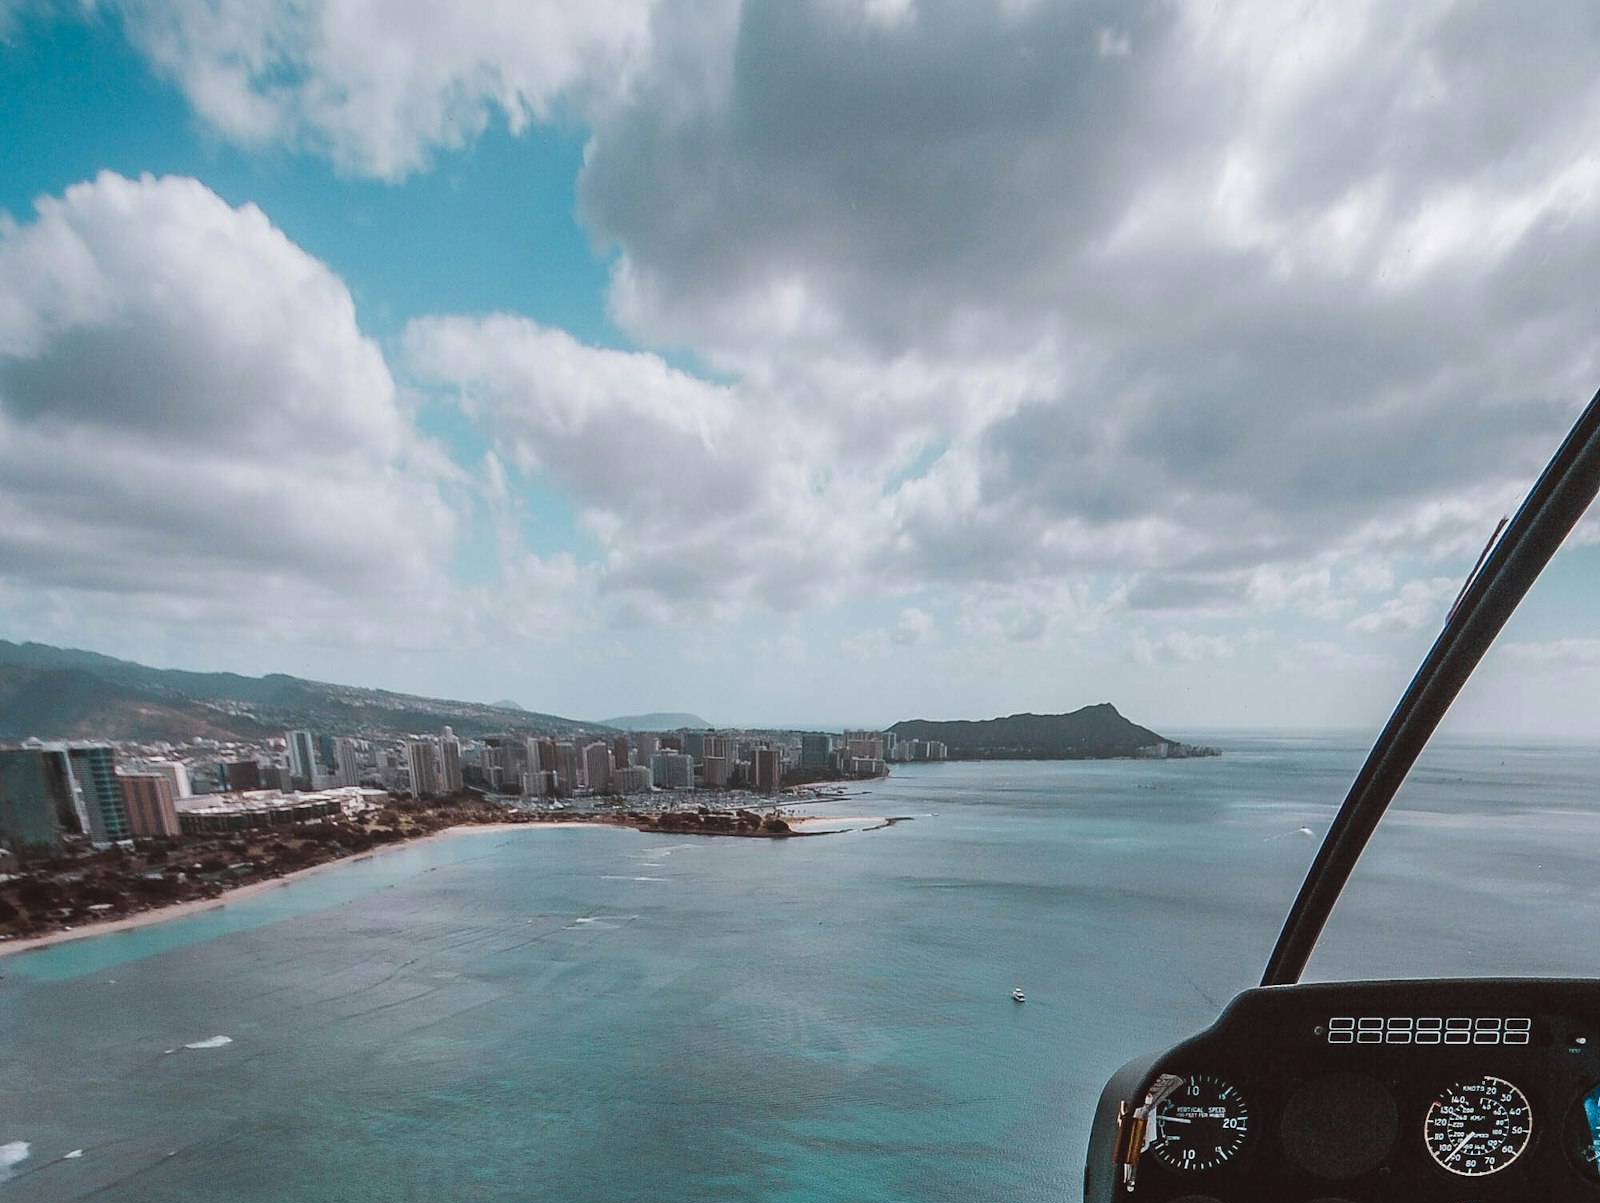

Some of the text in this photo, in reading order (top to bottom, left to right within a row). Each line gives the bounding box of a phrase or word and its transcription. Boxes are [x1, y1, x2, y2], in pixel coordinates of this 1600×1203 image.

[1186, 1085, 1201, 1096] 10
[1486, 1087, 1498, 1095] 20
[1500, 1093, 1513, 1102] 30
[1440, 1105, 1454, 1114] 130
[1509, 1107, 1522, 1116] 40
[1222, 1118, 1239, 1130] 20
[1434, 1118, 1449, 1127] 120
[1511, 1126, 1523, 1135] 50
[1439, 1144, 1453, 1152] 100
[1501, 1145, 1514, 1154] 60
[1182, 1149, 1197, 1160] 10
[1465, 1159, 1478, 1168] 80
[1484, 1156, 1496, 1165] 70
